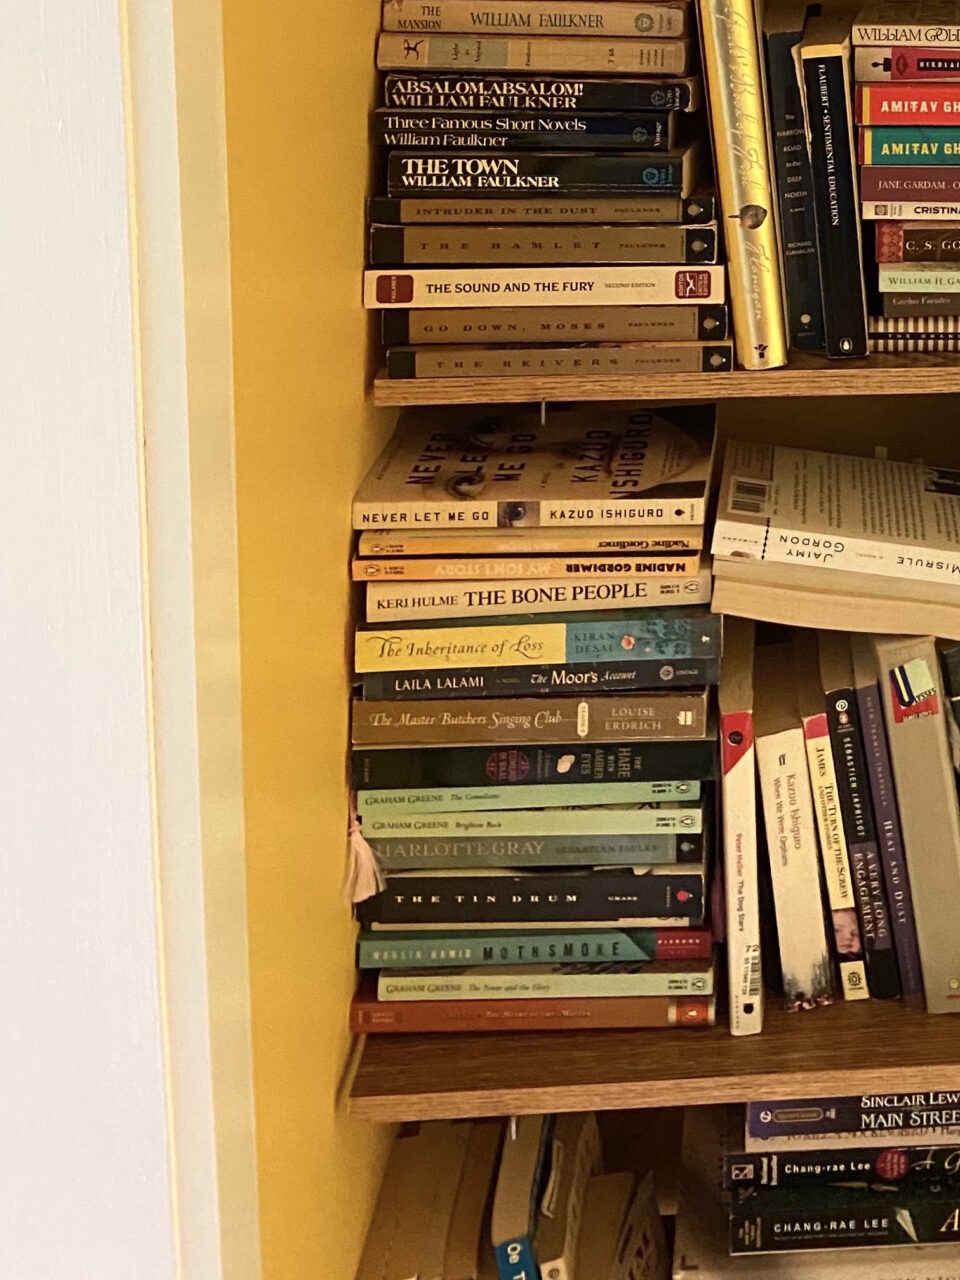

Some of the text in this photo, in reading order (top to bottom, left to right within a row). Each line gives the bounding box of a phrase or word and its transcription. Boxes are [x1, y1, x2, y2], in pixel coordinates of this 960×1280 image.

[881, 101, 938, 112] AMITAV
[384, 117, 586, 131] Three Famous Short Novels
[881, 143, 938, 154] AMITAV
[402, 159, 519, 175] THE TOWN
[402, 175, 559, 188] WILLIAM FAULKNER
[426, 281, 594, 294] THE SOUND AND THE FURY
[362, 511, 489, 524] NEVER LET ME GO
[550, 508, 664, 520] KAZUO ISHIGURO
[464, 583, 648, 606] THE BONE PEOPLE
[395, 677, 484, 691] LAILA LALAMI
[512, 894, 578, 902] DRUM
[861, 1112, 903, 1128] MAIN
[785, 1161, 846, 1175] Chang-rae
[850, 1161, 870, 1172] Lee
[774, 1219, 889, 1233] CHANG-RAE LEE
